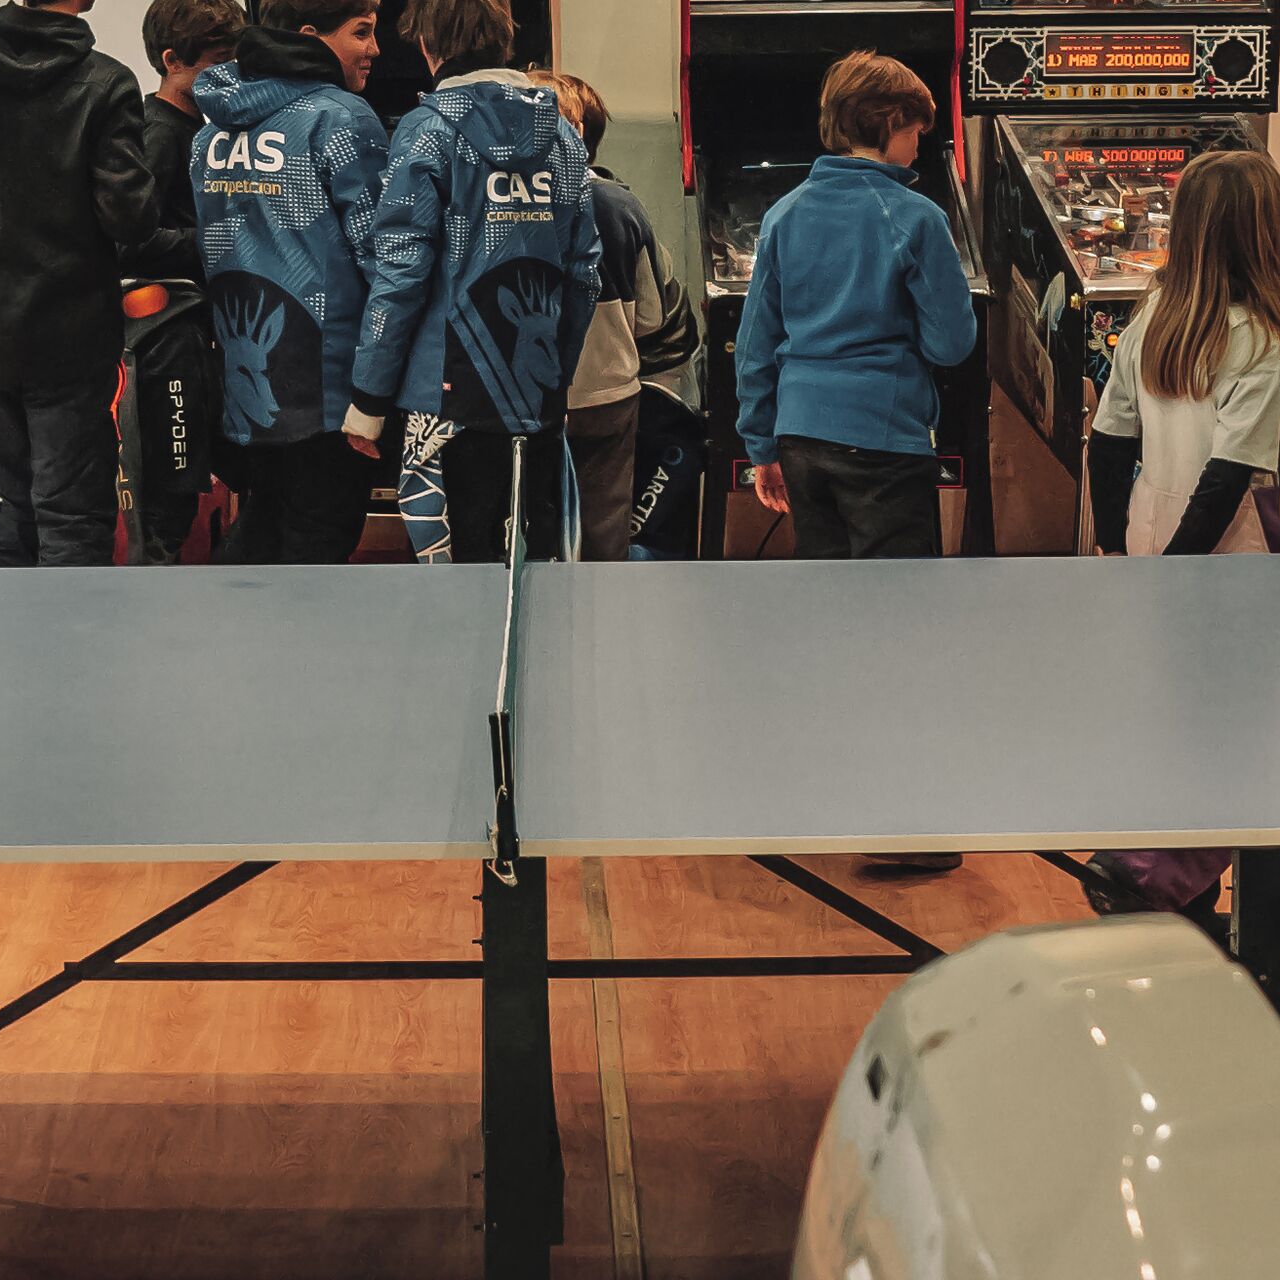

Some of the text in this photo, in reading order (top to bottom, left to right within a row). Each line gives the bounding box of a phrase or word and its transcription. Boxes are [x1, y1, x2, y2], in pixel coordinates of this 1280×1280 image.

[1069, 54, 1097, 67] MAB
[1105, 54, 1190, 68] 200,000,000
[207, 131, 285, 172] CAS
[486, 171, 553, 204] CAS
[169, 380, 186, 470] SPYDER
